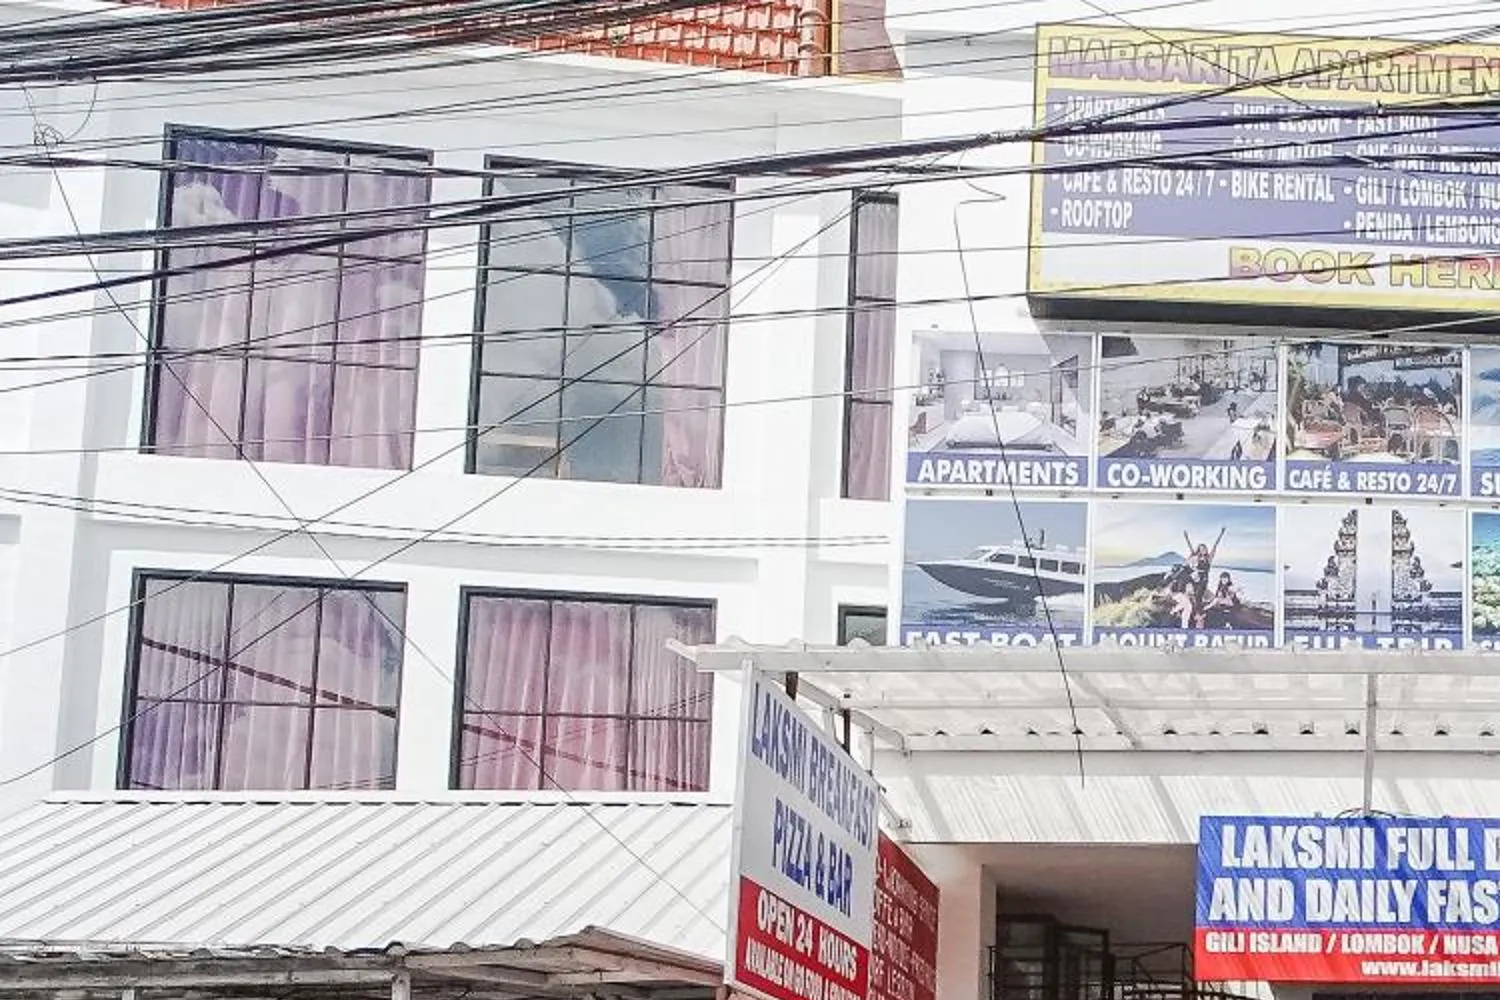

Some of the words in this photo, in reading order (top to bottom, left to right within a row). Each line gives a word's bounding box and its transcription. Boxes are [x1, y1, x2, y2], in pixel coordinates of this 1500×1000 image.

[1049, 36, 1281, 86] MARGARITA
[1122, 170, 1172, 196] RESTO
[1231, 171, 1270, 200] BIKE
[1273, 173, 1335, 202] RENTAL
[1355, 180, 1387, 206] GILI
[1400, 182, 1467, 210] LOMBOK
[1060, 199, 1134, 230] ROOFTOP
[1355, 212, 1414, 242] PENIDA
[1228, 246, 1376, 286] BOOK
[917, 457, 1079, 487] APARTMENTS
[1106, 461, 1268, 489] CO-WORKING
[1289, 464, 1333, 491] CAFÉ
[1337, 471, 1351, 491] &
[1356, 470, 1412, 493] RESTO
[1416, 472, 1457, 496] 24/7
[752, 681, 808, 796] LAKSMI
[810, 738, 878, 852] BREAKFAST
[772, 796, 812, 892] PIZZA
[814, 830, 826, 902] &
[827, 841, 853, 919] BAR
[1220, 823, 1376, 870] LAKSMI
[1385, 825, 1476, 871] FULL
[1207, 876, 1295, 923] AND
[1304, 878, 1419, 924] DAILY
[757, 888, 795, 947] OPEN
[796, 913, 813, 958] 24
[817, 925, 858, 982] HOURS
[1205, 931, 1246, 954] GILI
[1249, 932, 1323, 955] ISLAND
[1341, 933, 1425, 956] LOMBOK
[1443, 934, 1498, 956] NUSA
